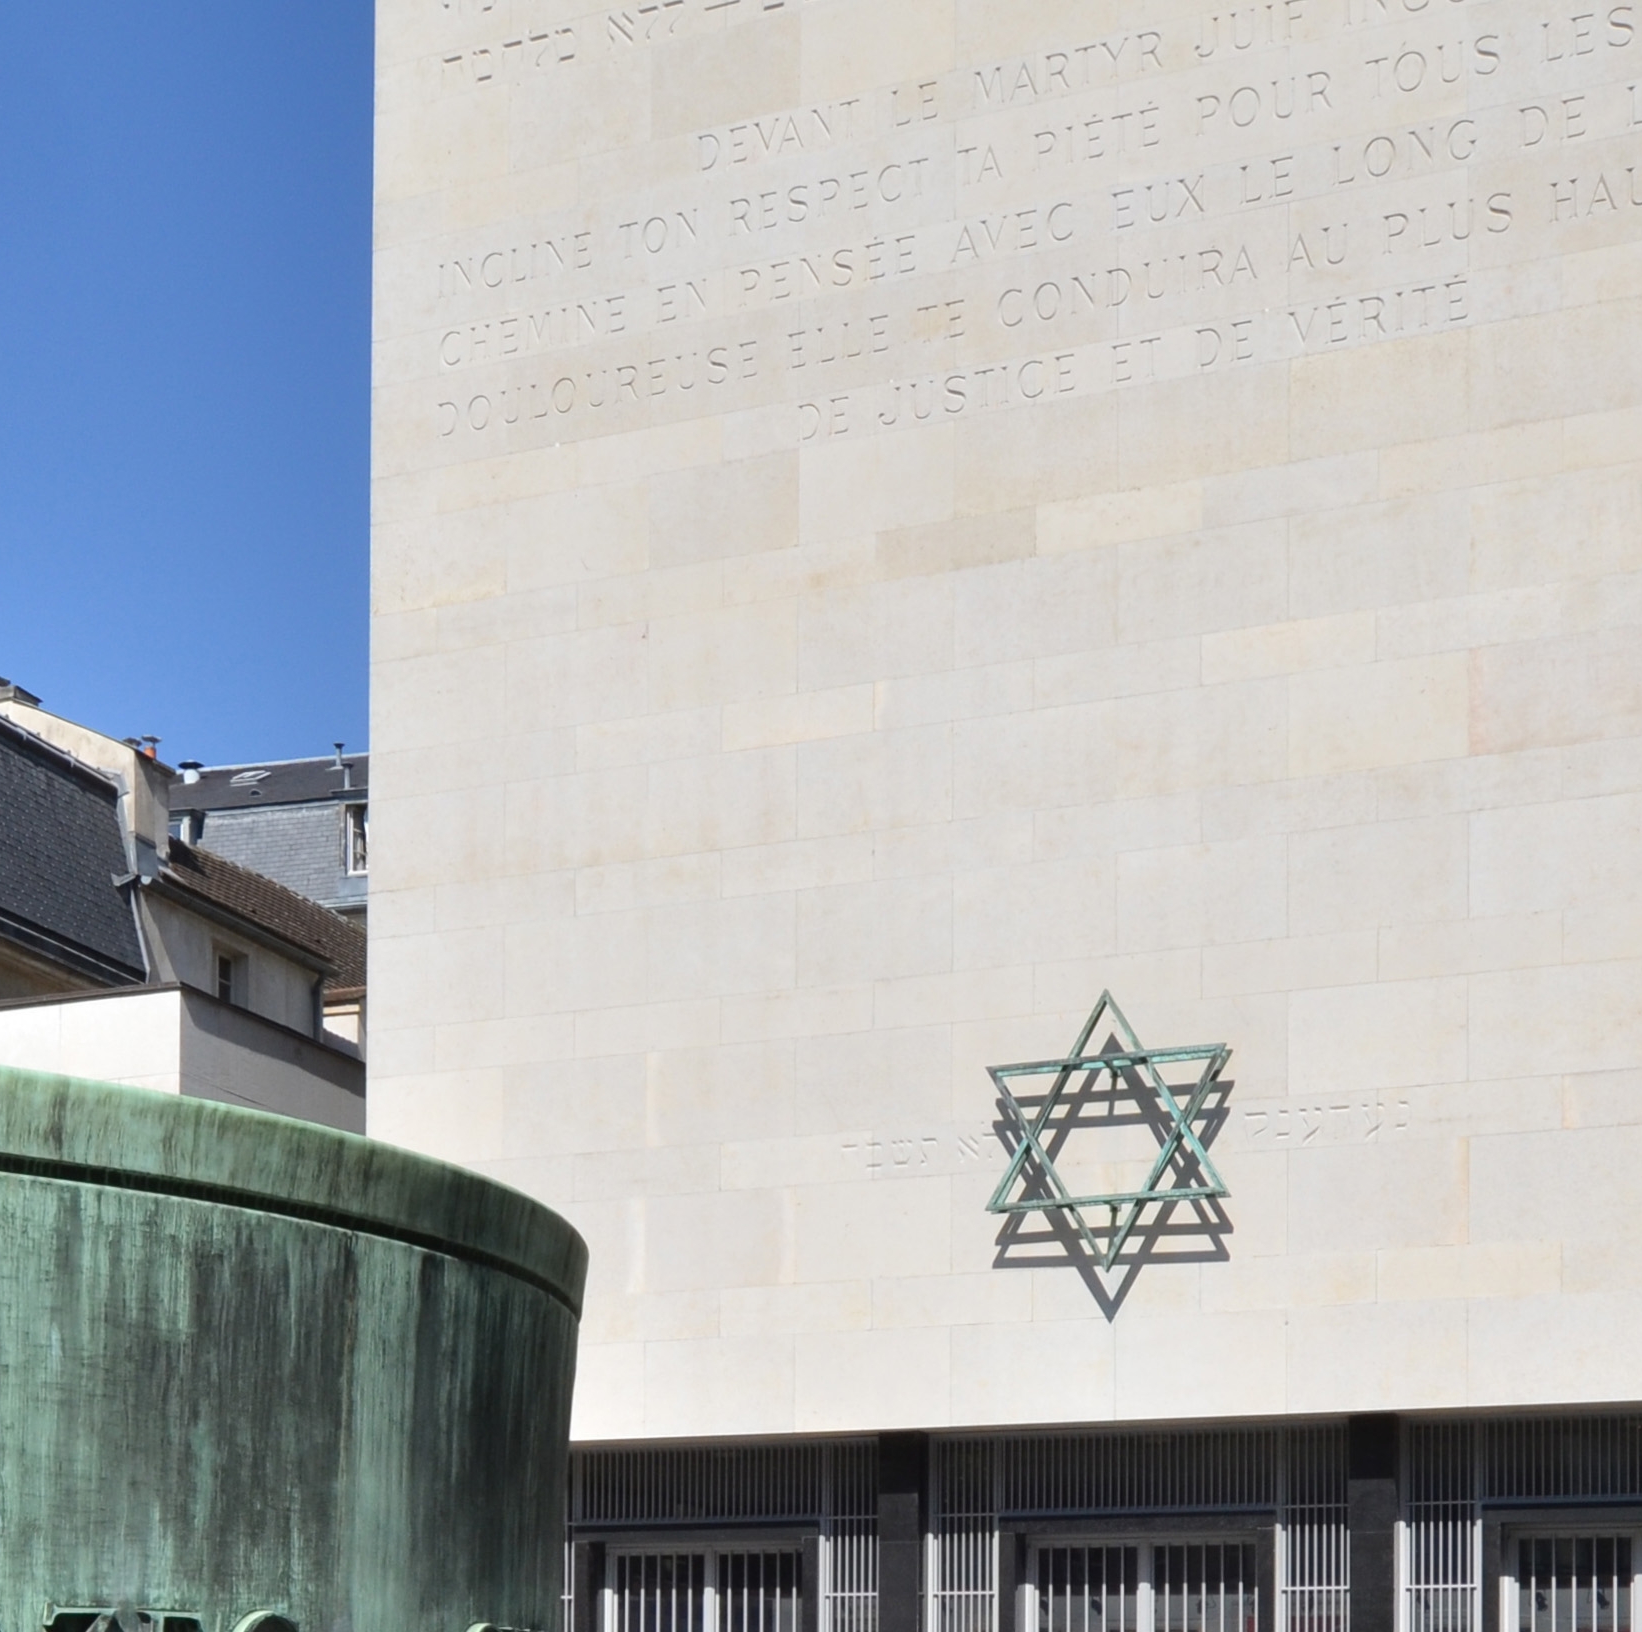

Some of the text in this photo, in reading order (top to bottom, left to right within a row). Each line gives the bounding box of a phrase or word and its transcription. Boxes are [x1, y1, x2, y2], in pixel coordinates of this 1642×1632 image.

[437, 231, 592, 299] INCLINE
[618, 208, 700, 257] TON
[728, 157, 930, 237] RESPECT
[958, 144, 1003, 187] TA
[1034, 99, 1160, 161] PIÉTÉ
[1195, 69, 1333, 137] POUR
[1365, 33, 1502, 101] TOUS
[1541, 5, 1636, 66] LES
[698, 100, 860, 172] DEVANT
[891, 81, 940, 127] LE
[974, 30, 1164, 110] MARTYR
[1194, 0, 1303, 57] JUIF
[438, 341, 759, 438] DOULOUREUSE
[786, 315, 890, 370] ELLE
[917, 299, 966, 342] TE
[997, 246, 1258, 329] CONDUIRA
[1286, 221, 1350, 274] AU
[1382, 190, 1514, 257] PLUS
[440, 295, 627, 367] CHEMINE
[657, 278, 708, 324] EN
[739, 235, 917, 310] PENSÉE
[951, 202, 1075, 264] AVEC
[1111, 174, 1207, 232] EUX
[1238, 156, 1294, 207] LE
[1333, 118, 1478, 189] LONG
[1518, 95, 1587, 149] DE
[798, 274, 1470, 442] DE JUSTICE ET DE VÉRITÉ
